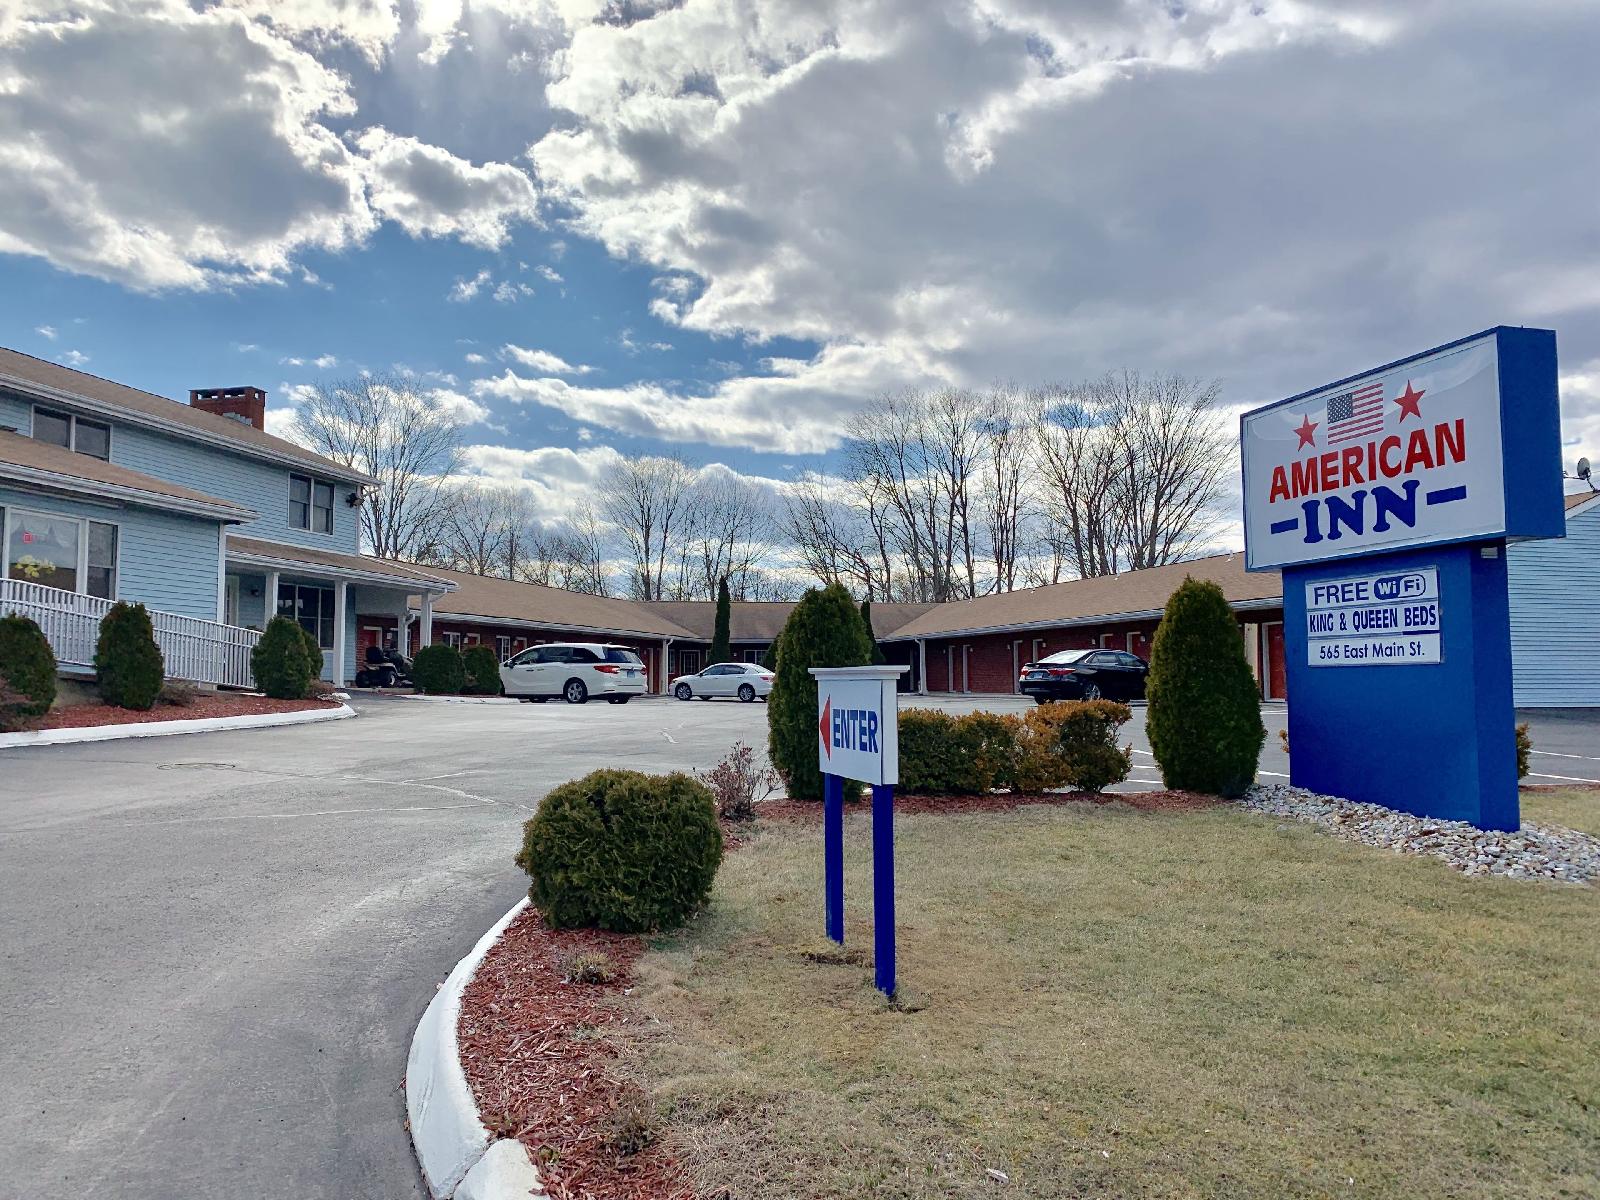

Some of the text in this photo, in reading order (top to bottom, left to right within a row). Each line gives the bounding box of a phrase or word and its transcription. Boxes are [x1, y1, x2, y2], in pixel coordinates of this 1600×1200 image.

[1269, 418, 1466, 504] AMERICAN
[1313, 577, 1422, 605] FREE WiFi
[1309, 613, 1334, 632] KING
[1339, 612, 1347, 631] &
[1404, 605, 1436, 626] BEDS
[1320, 641, 1425, 659] 565 East Main St.
[832, 708, 879, 754] ENTER
